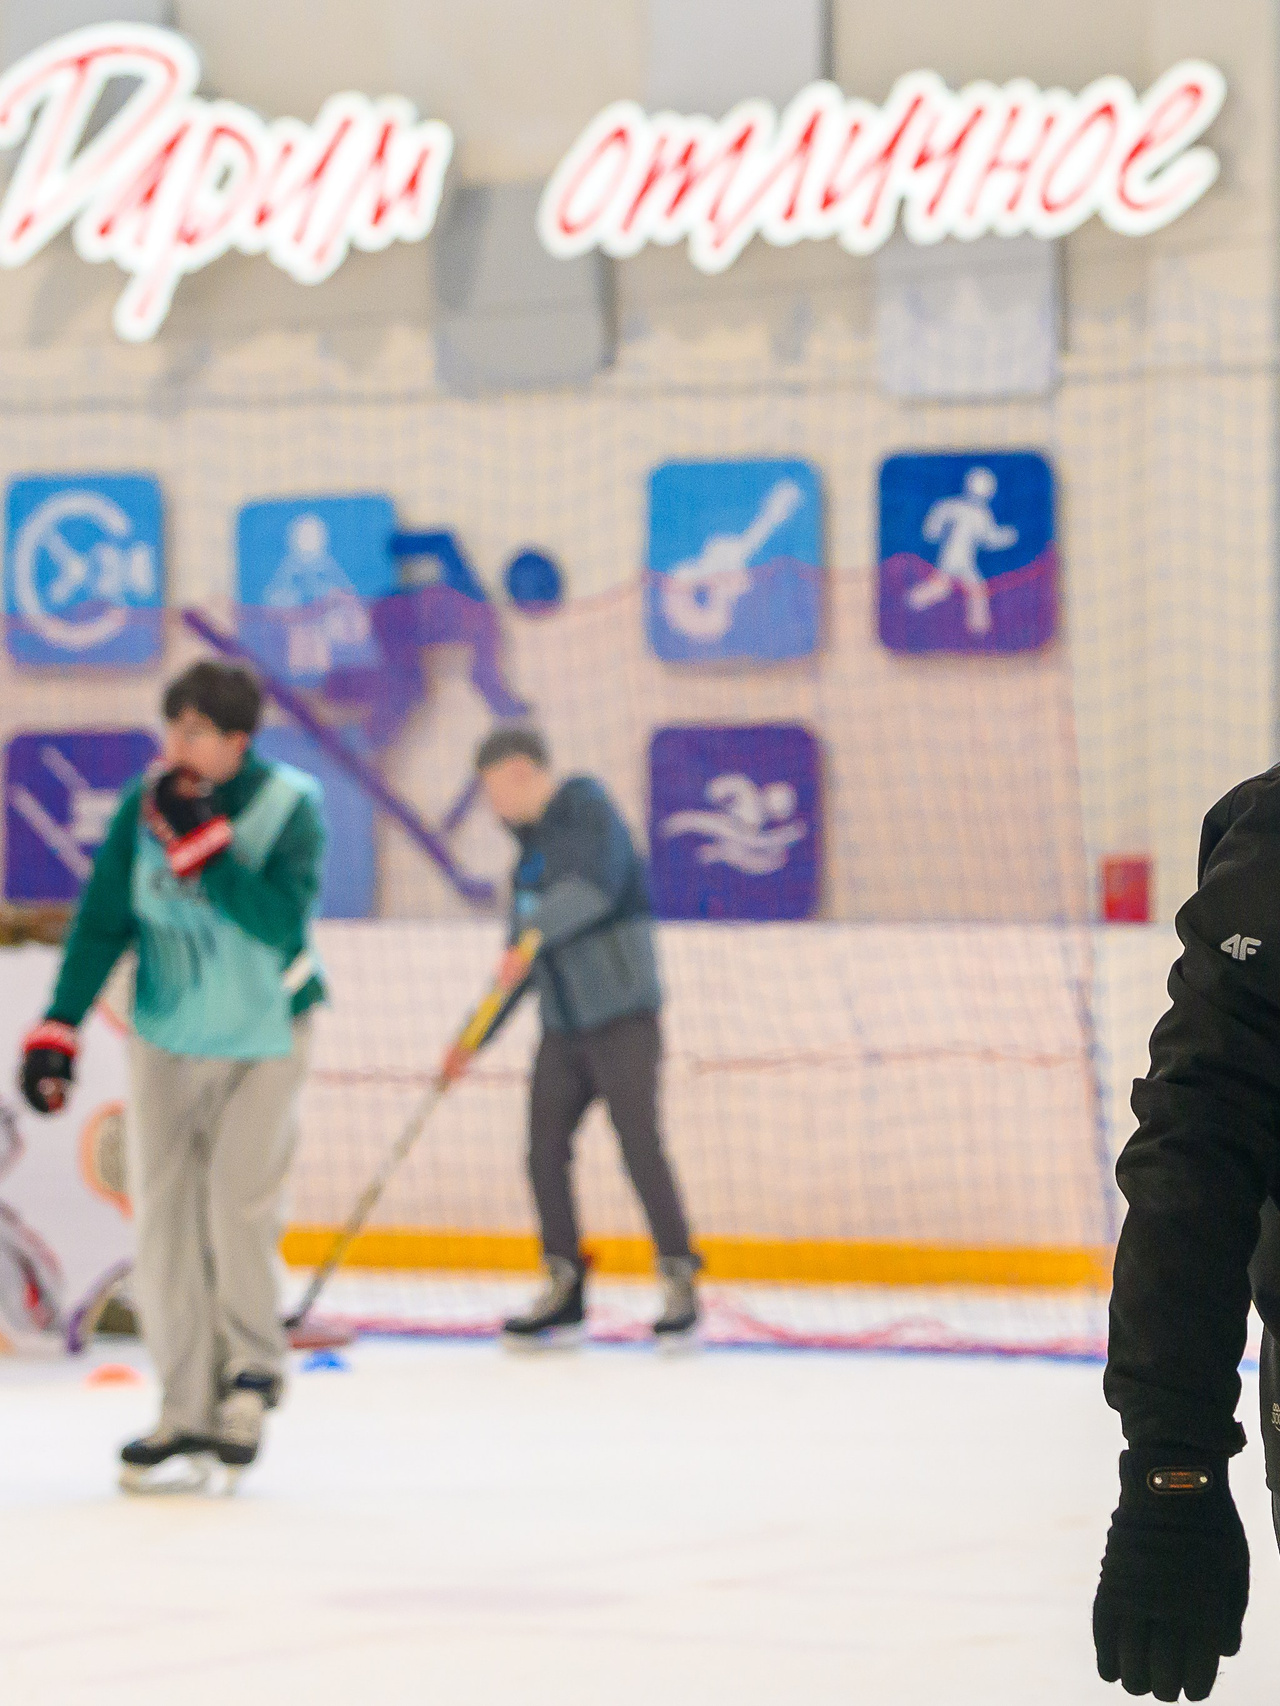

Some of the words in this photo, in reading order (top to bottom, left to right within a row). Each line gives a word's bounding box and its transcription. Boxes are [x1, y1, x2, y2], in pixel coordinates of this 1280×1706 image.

[0, 29, 446, 333] Дарим
[542, 65, 1220, 266] отличное
[1221, 934, 1262, 960] 4F
